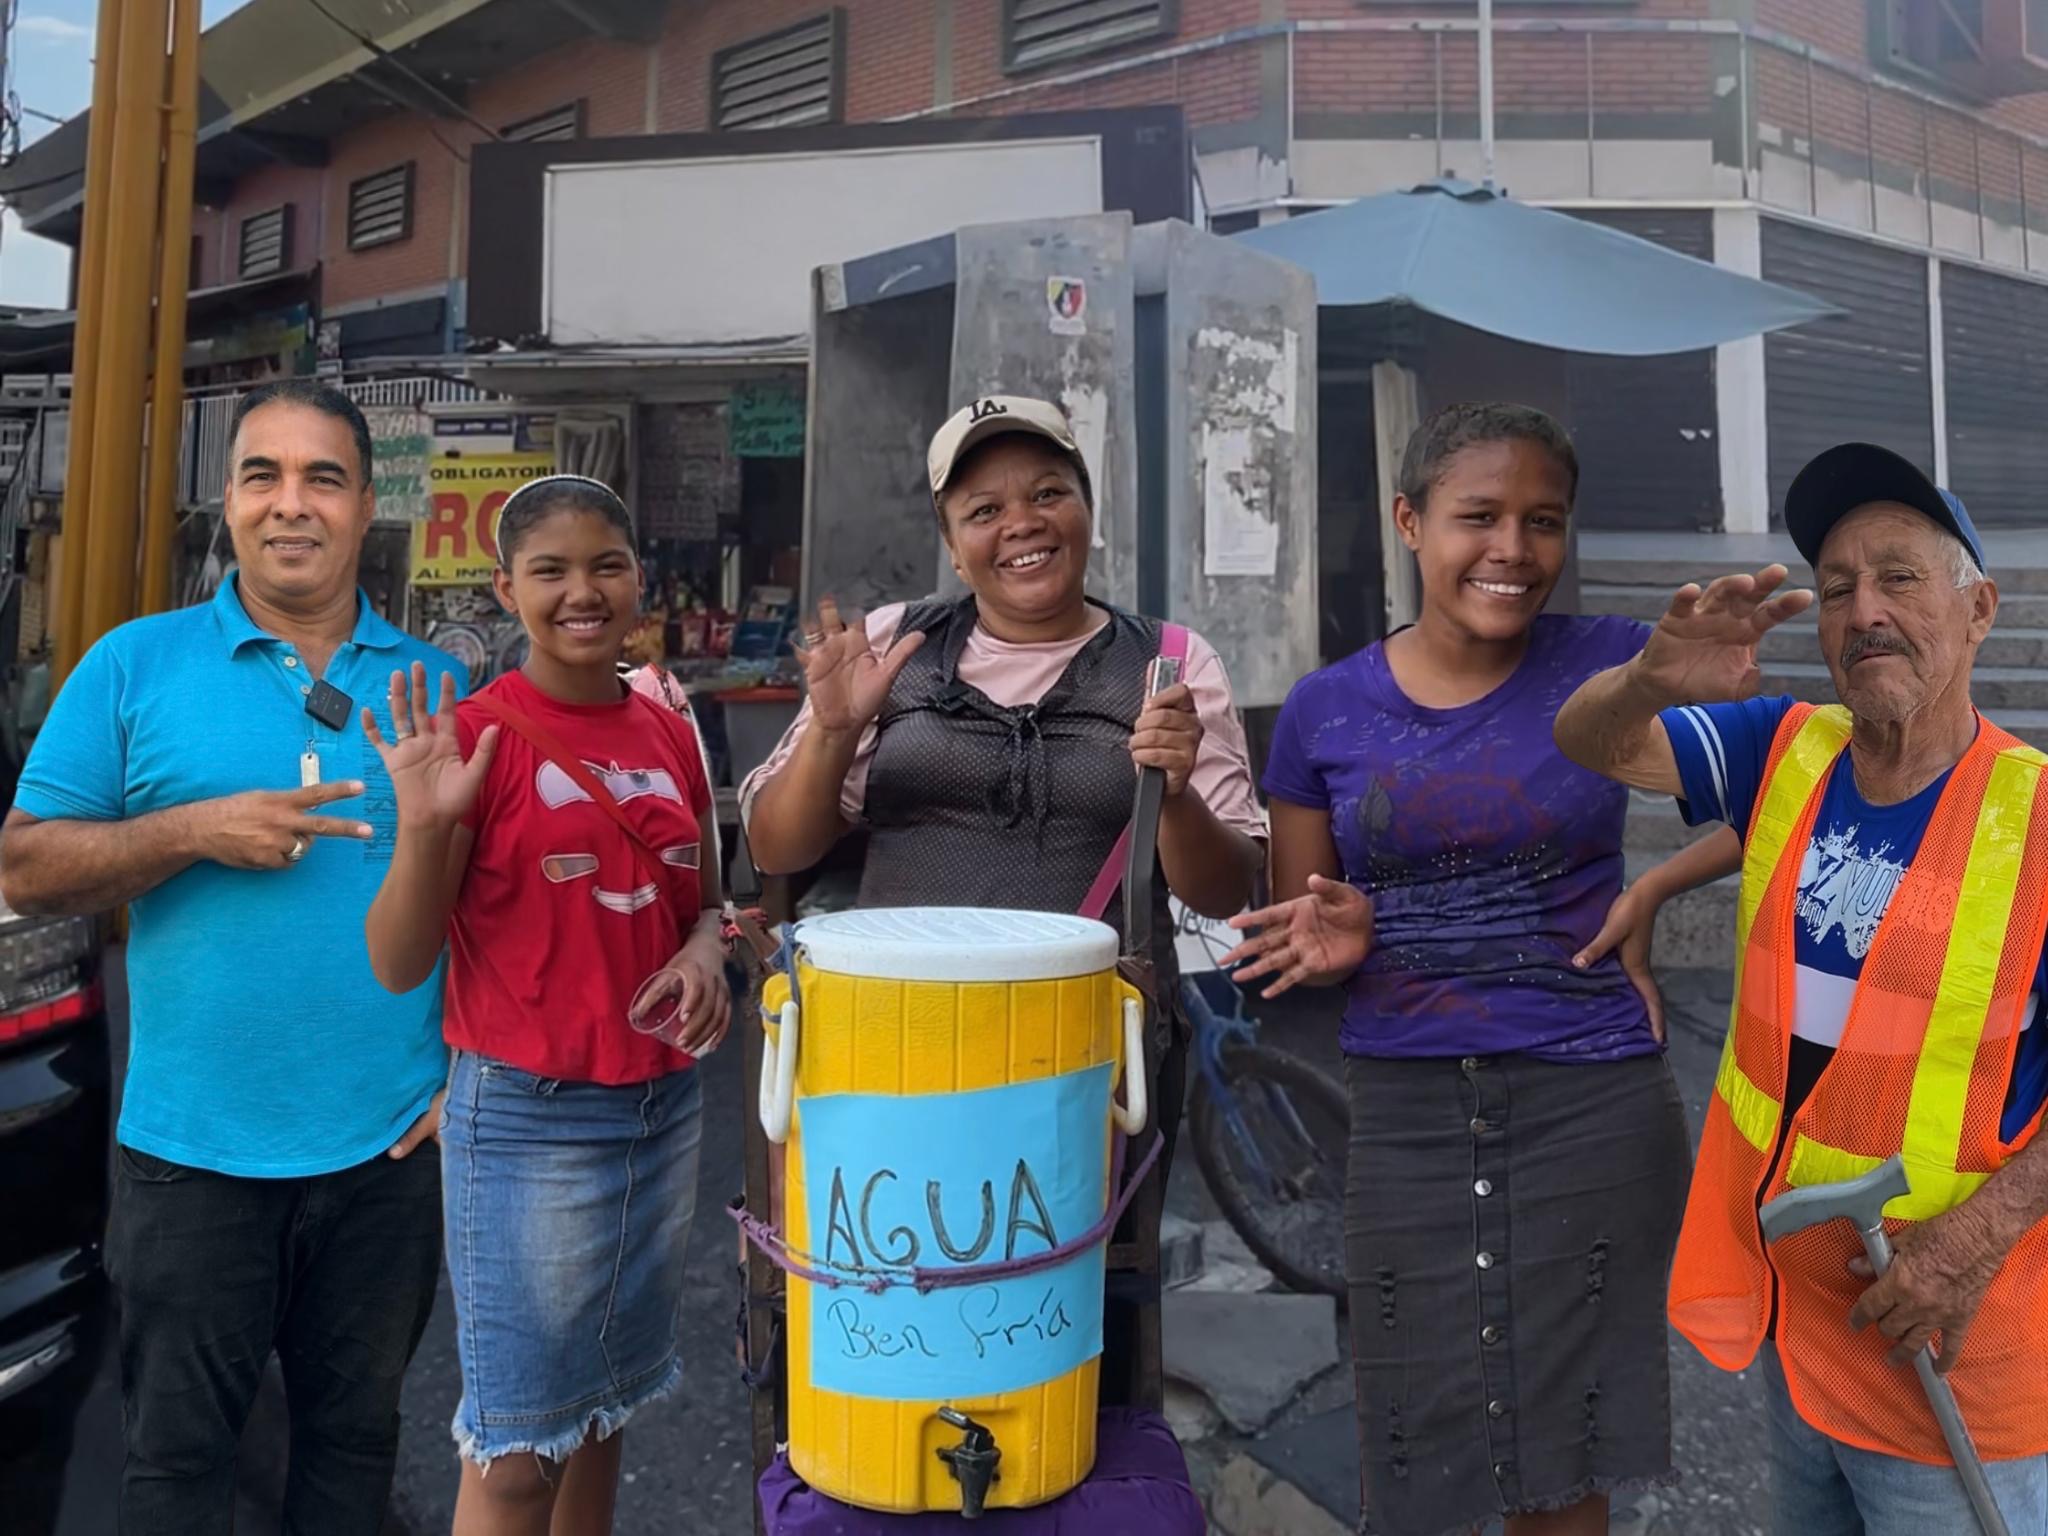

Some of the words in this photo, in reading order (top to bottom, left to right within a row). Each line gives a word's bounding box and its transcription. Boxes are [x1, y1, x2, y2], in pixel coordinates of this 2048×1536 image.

[430, 466, 555, 481] OBLIGATORI
[415, 568, 447, 580] AL
[826, 1158, 1061, 1276] AGUA
